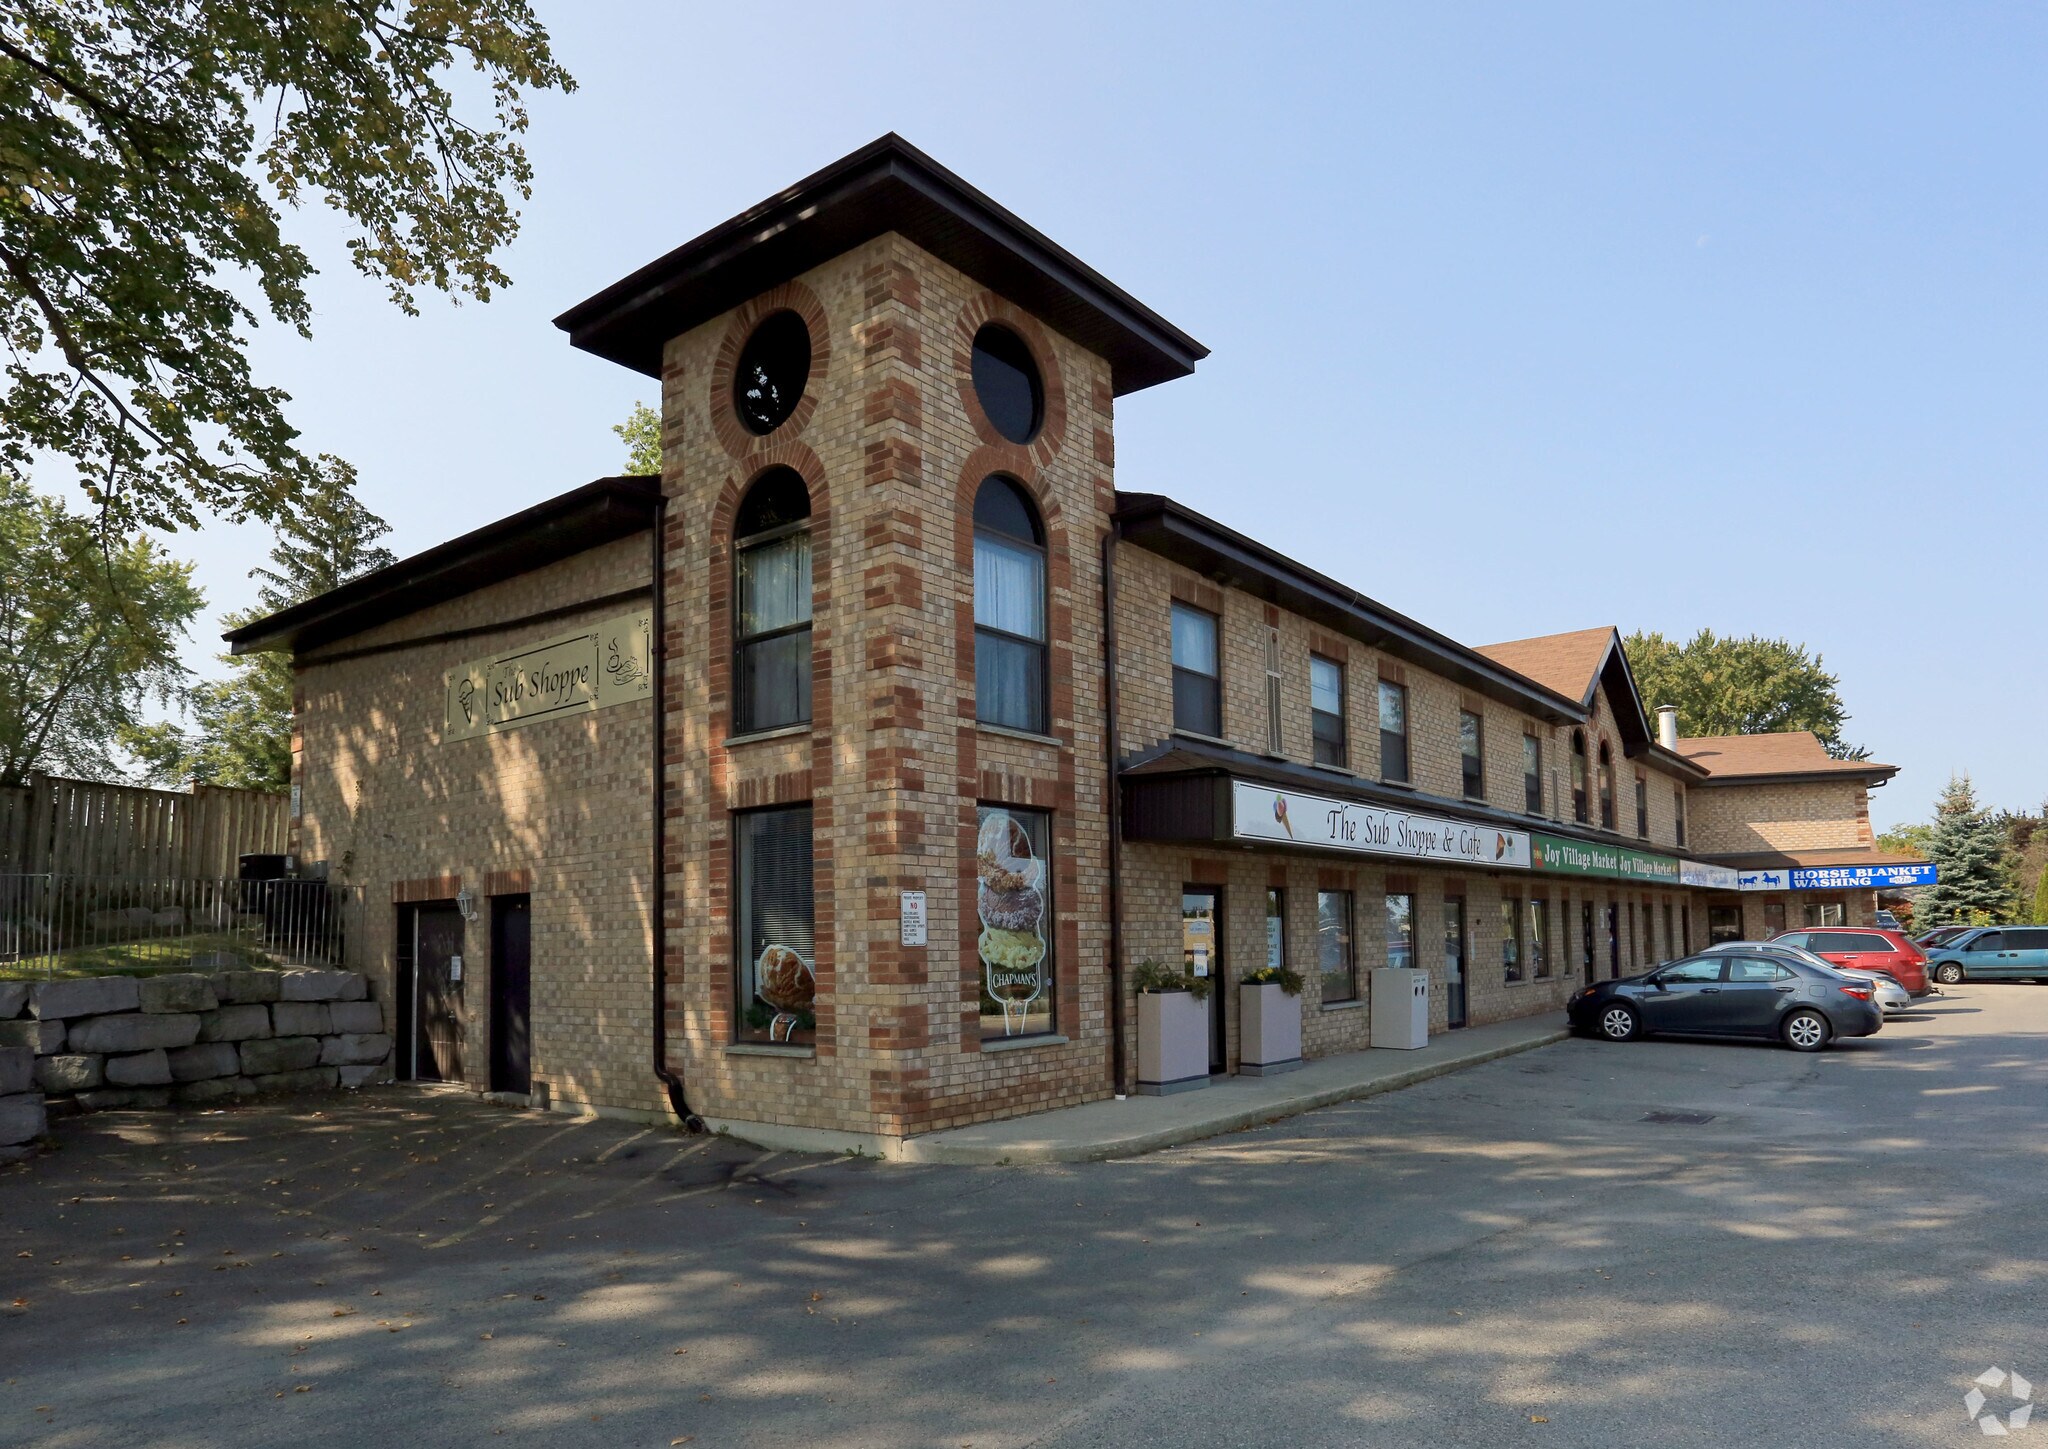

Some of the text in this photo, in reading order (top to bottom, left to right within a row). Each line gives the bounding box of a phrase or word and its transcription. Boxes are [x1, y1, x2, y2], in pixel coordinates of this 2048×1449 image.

[493, 661, 588, 706] Sub Shoppe
[1327, 804, 1481, 862] The Sub Shoppe & Cafe
[1544, 844, 1617, 870] Joy Village Market
[1620, 855, 1631, 874] Joy
[1632, 857, 1653, 877] Village
[1654, 861, 1672, 877] Market
[1793, 865, 1932, 880] HORSE BLANKET
[1794, 877, 1872, 888] WASHING
[992, 973, 1037, 988] CHAPMAN'S
